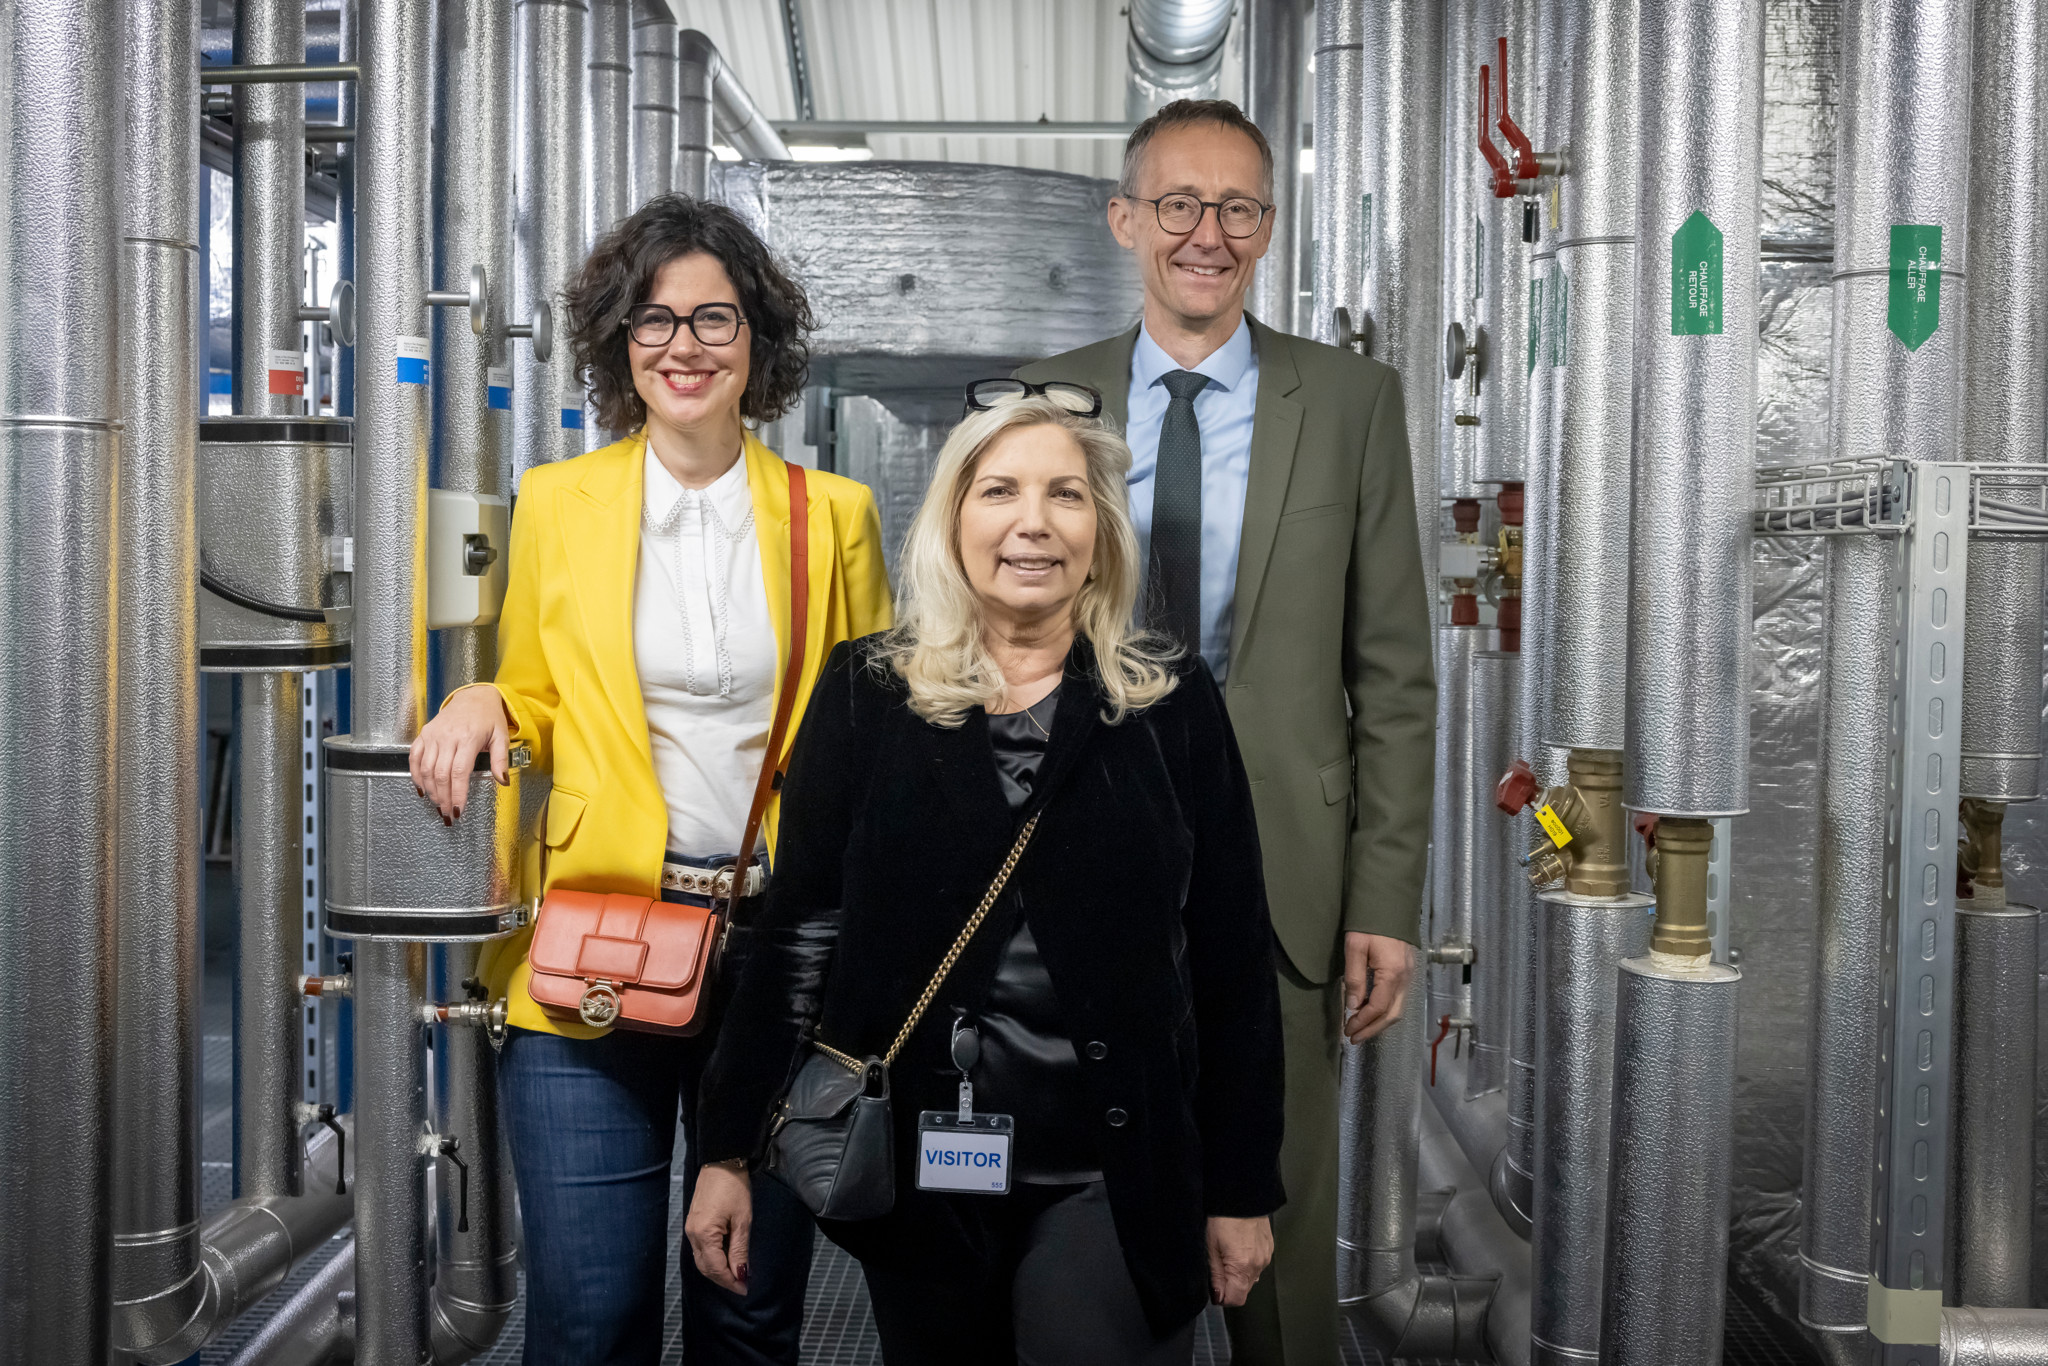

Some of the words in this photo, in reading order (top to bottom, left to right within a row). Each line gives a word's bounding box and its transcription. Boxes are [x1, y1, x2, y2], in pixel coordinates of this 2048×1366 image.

[1688, 270, 1698, 309] RETOUR
[1699, 261, 1708, 317] CHAUFFAGE
[1907, 259, 1916, 289] ALLER
[1917, 246, 1928, 303] CHAUFFAGE
[925, 1149, 1001, 1168] VISITOR
